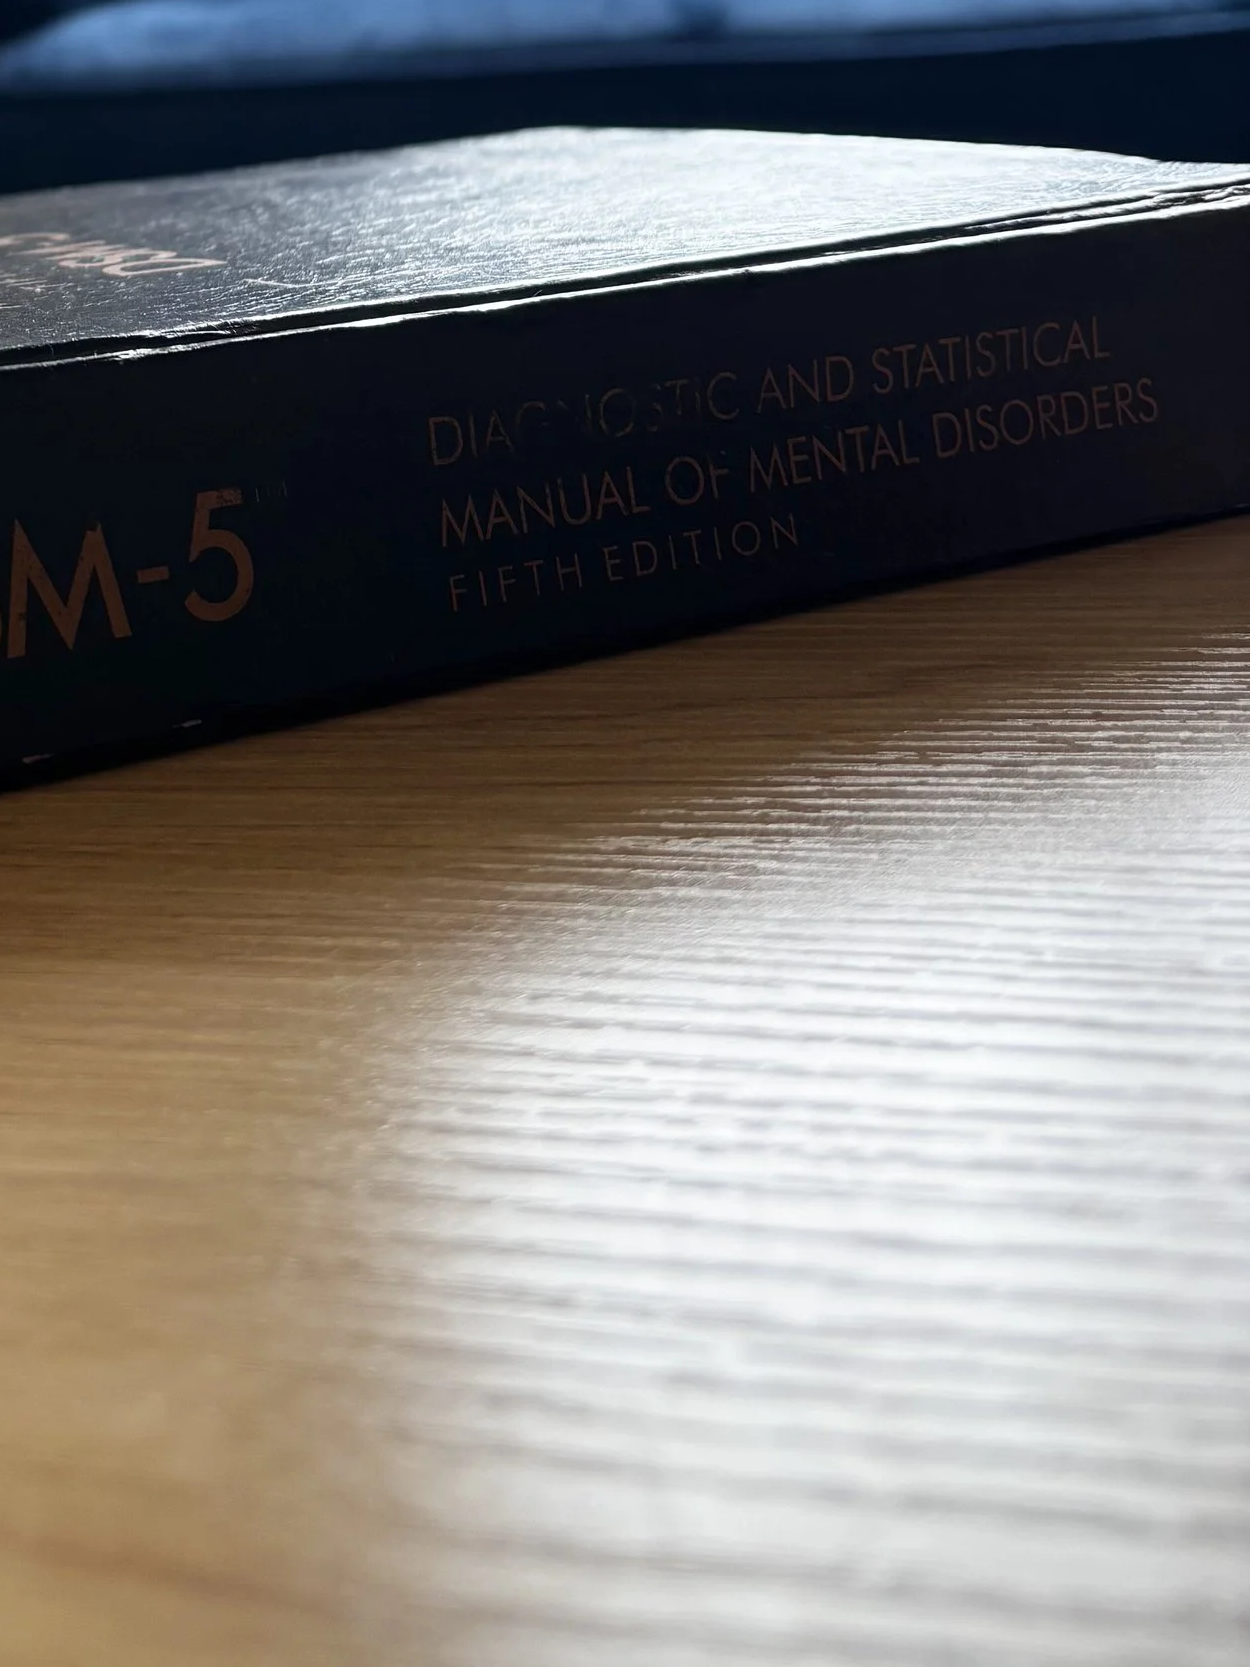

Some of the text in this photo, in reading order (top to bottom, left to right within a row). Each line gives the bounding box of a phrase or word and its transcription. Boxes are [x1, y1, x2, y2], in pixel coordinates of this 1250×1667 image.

[755, 355, 855, 415] AND
[871, 315, 1111, 395] STATISTICAL
[440, 376, 1160, 548] MANUAL OF MENTAL DISORDERS
[448, 512, 800, 613] FIFTH EDITION
